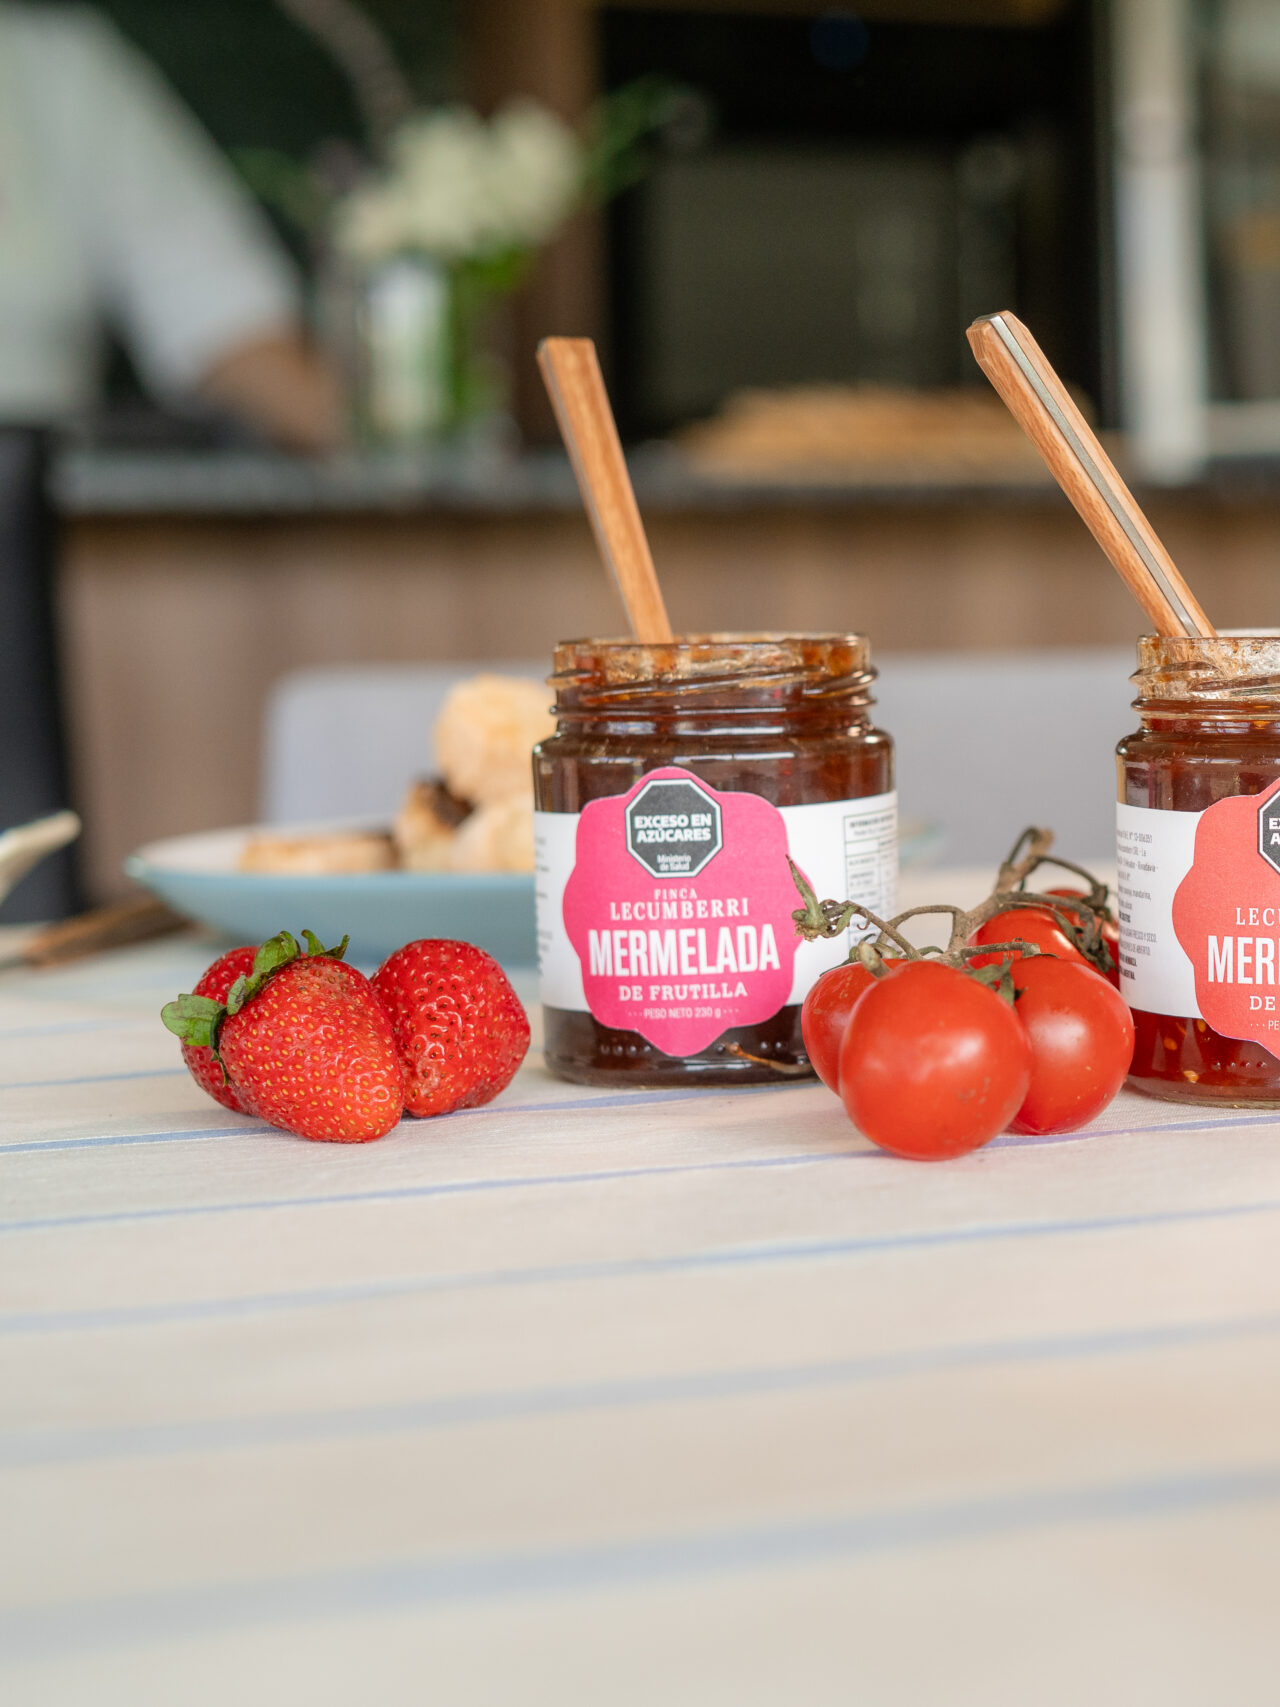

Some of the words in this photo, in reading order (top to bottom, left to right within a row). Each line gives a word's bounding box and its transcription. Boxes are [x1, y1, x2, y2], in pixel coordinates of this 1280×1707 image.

[634, 814, 689, 829] EXCESO
[690, 813, 712, 827] EN
[636, 827, 711, 843] AZÚCARES
[654, 888, 698, 900] FINCA
[610, 897, 749, 921] LECUMBERRI
[588, 923, 781, 977] MERMELADA
[618, 985, 643, 1001] DE
[650, 982, 748, 1001] FRUTILLA
[1249, 995, 1276, 1011] DE
[643, 1008, 667, 1019] PESO
[668, 1007, 693, 1019] NETO
[694, 1007, 713, 1018] 230
[715, 1009, 721, 1019] g
